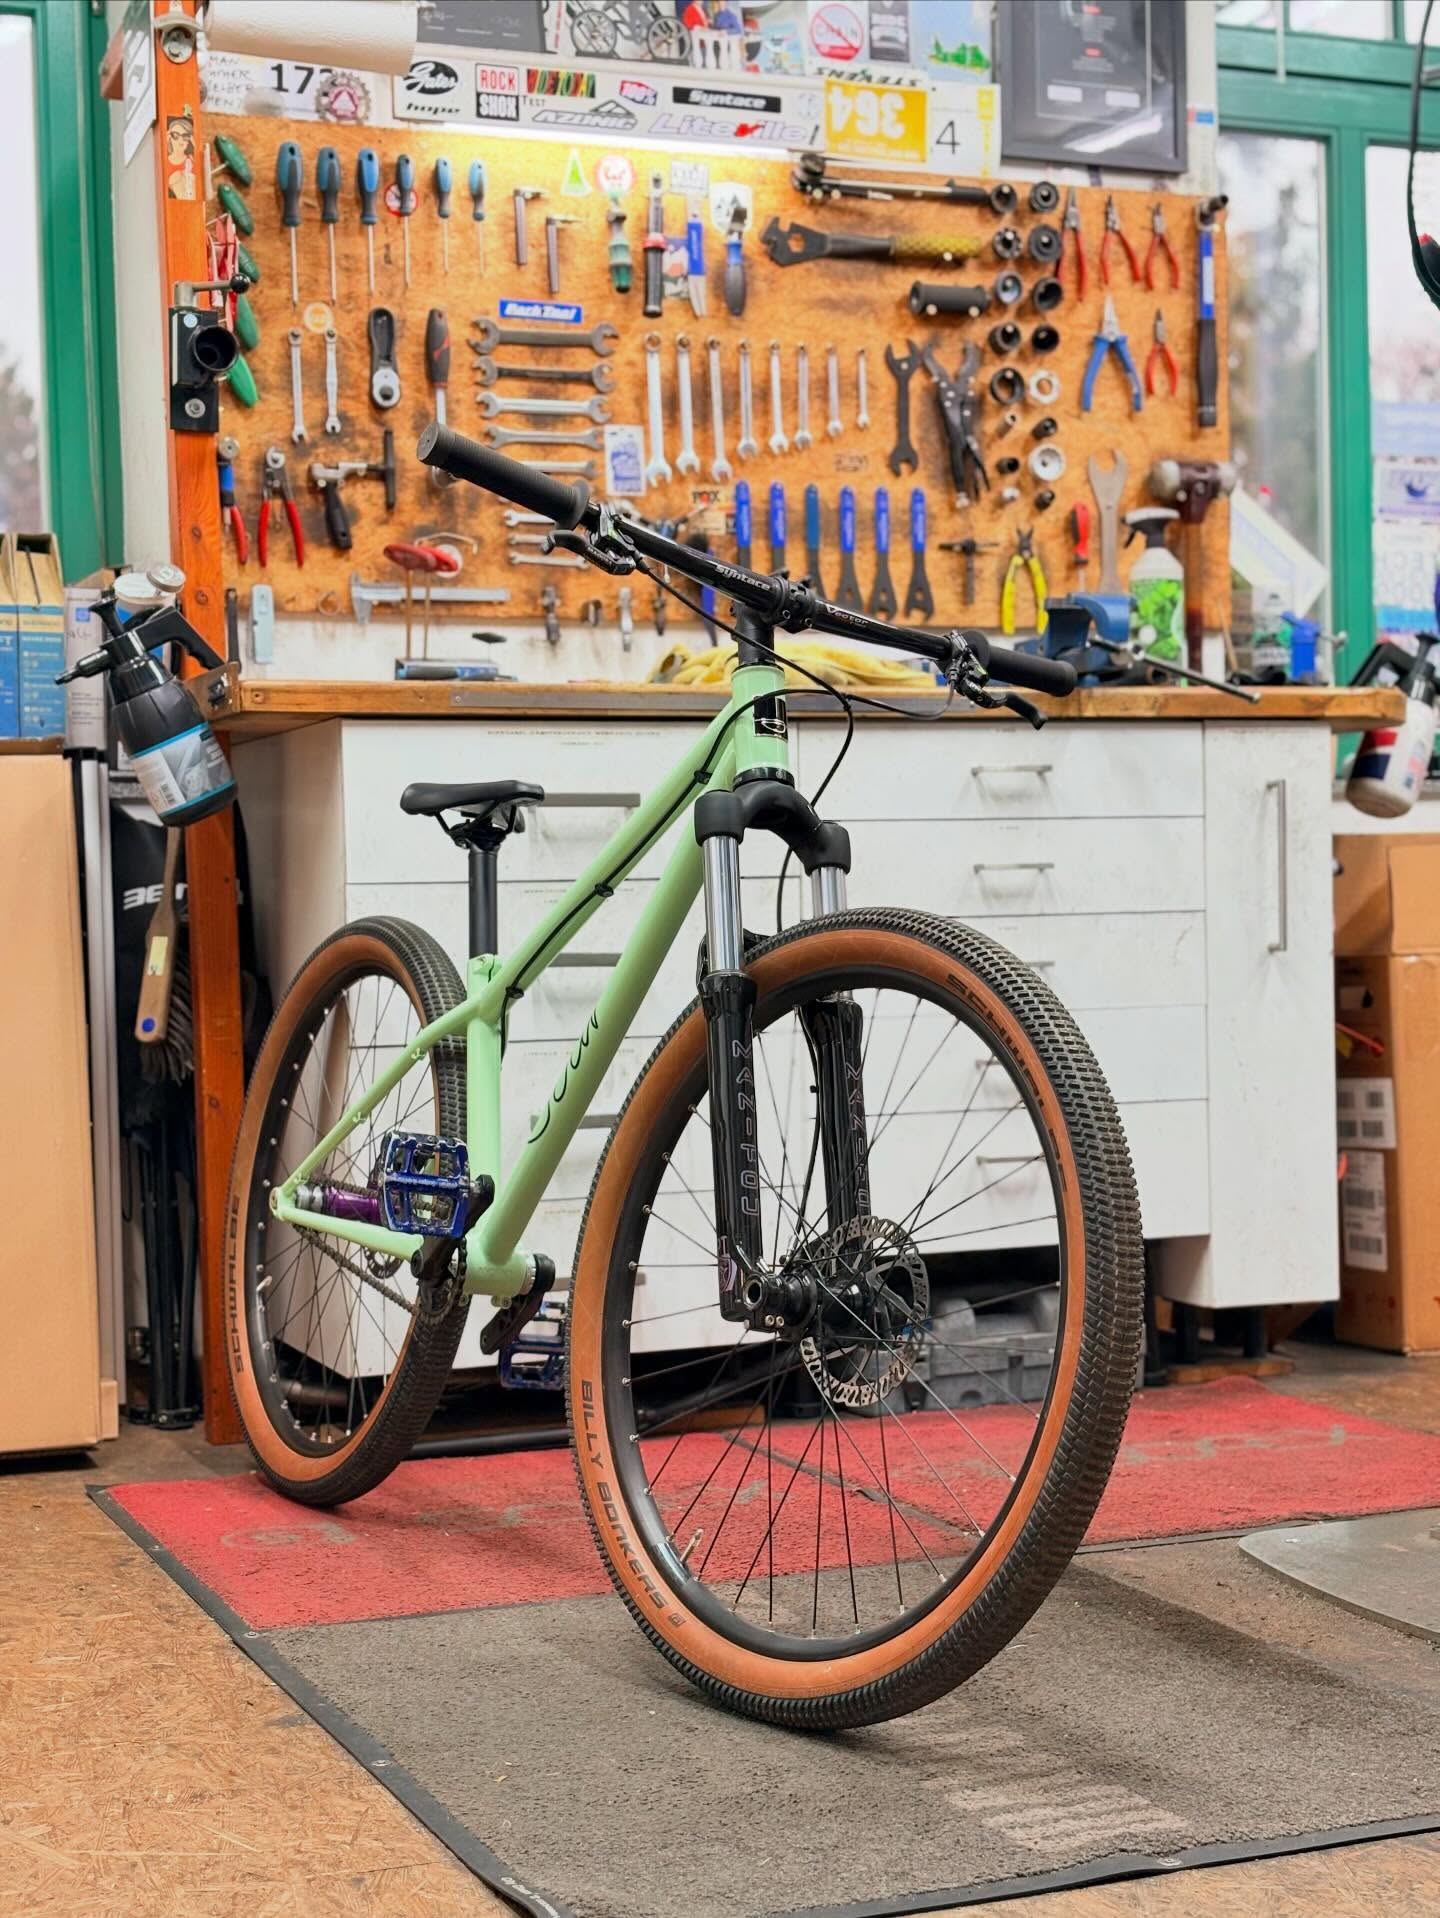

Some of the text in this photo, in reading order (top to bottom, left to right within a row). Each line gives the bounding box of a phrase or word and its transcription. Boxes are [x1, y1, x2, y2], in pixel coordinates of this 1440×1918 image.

[480, 69, 516, 91] ROCK
[479, 93, 517, 119] SHOX
[688, 90, 767, 110] Syntace
[829, 86, 905, 139] 364
[649, 113, 807, 141] Liteville
[935, 120, 960, 154] 4
[714, 563, 772, 591] Syntace
[731, 1040, 760, 1216] MANITOU
[229, 1194, 244, 1374] SCHWALBE
[581, 1378, 669, 1610] BILLY BONKERS
